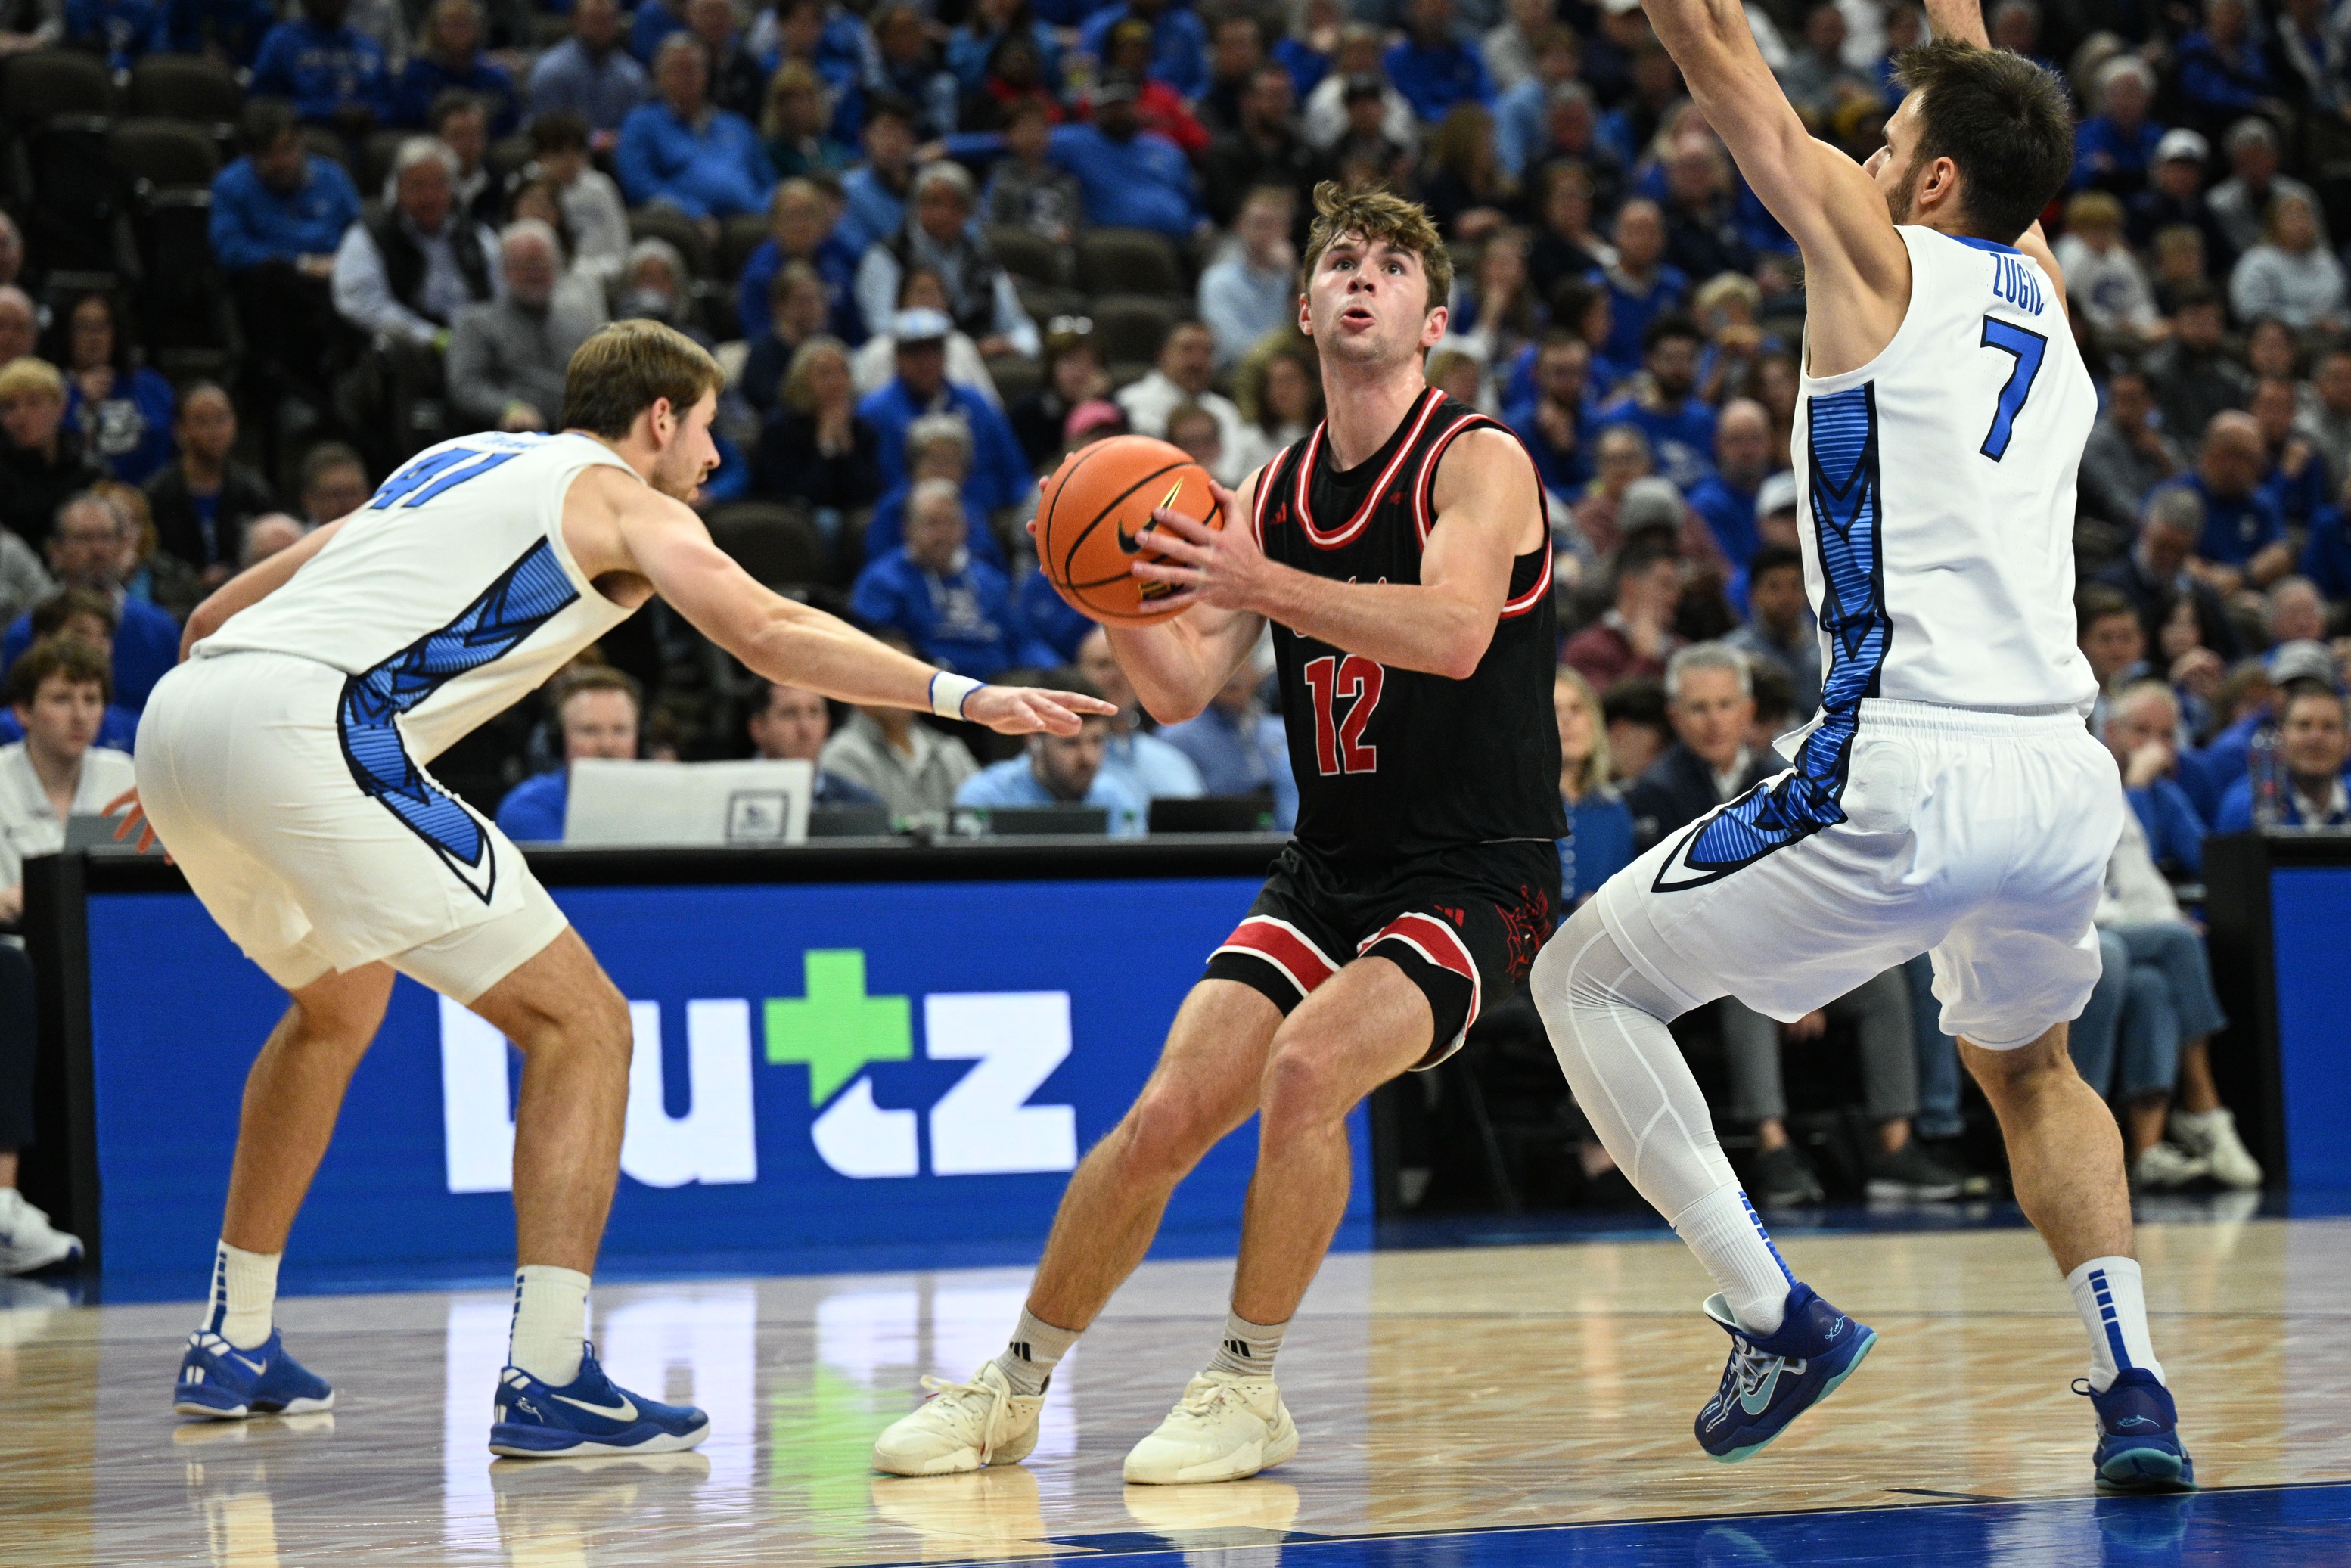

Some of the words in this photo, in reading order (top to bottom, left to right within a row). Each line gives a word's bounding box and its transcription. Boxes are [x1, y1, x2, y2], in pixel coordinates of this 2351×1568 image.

[1979, 314, 2048, 463] 7
[368, 447, 523, 509] 41
[1304, 654, 1384, 776] 12
